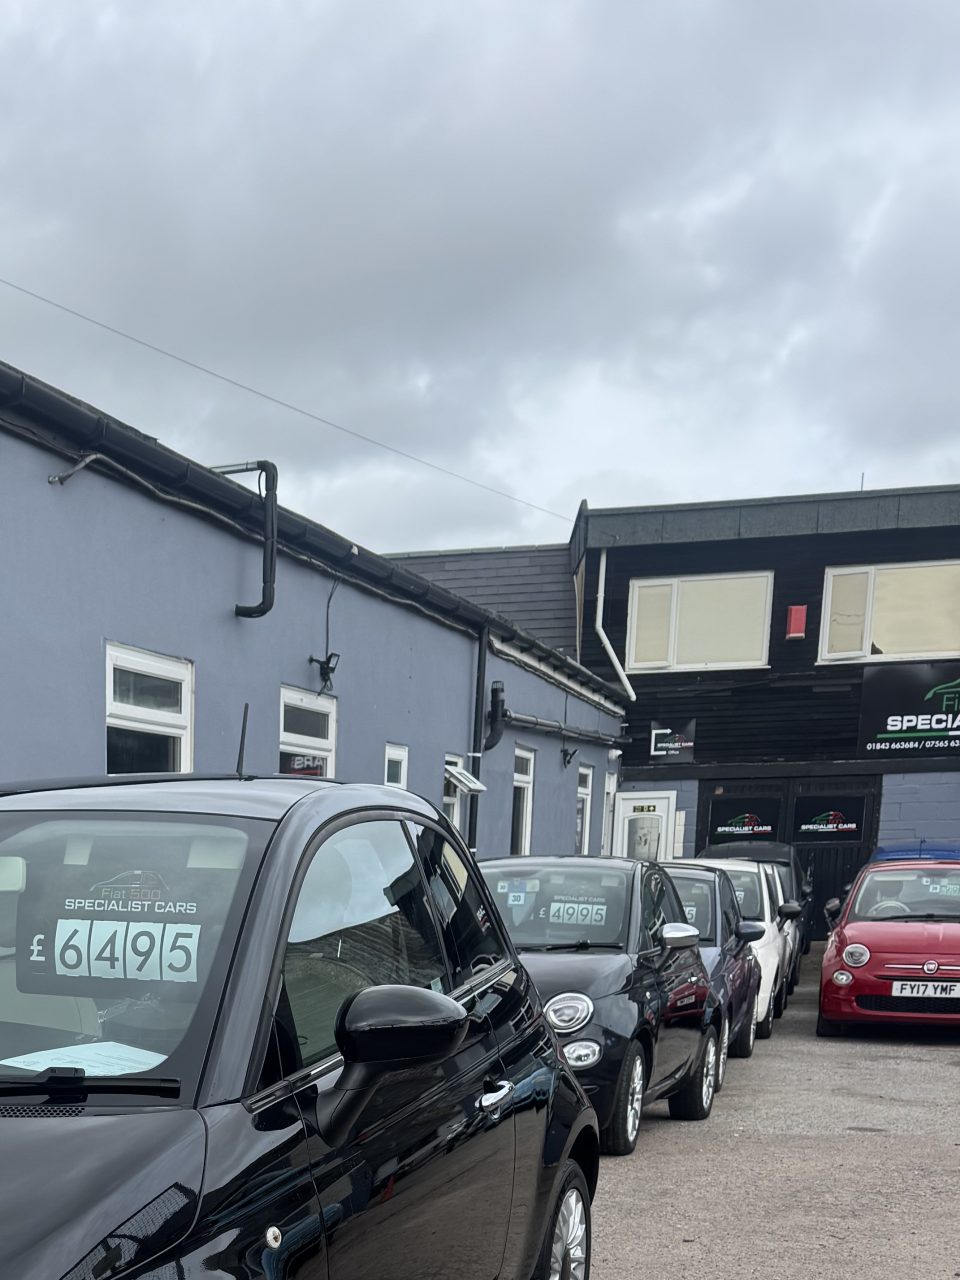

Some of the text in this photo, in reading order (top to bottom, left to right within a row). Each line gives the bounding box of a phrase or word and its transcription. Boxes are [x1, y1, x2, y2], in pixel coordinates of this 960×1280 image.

[101, 888, 160, 901] Fiat 500
[512, 894, 521, 903] 30
[64, 898, 197, 914] SPECIALIST CARS
[900, 983, 957, 995] FY17 YMF
